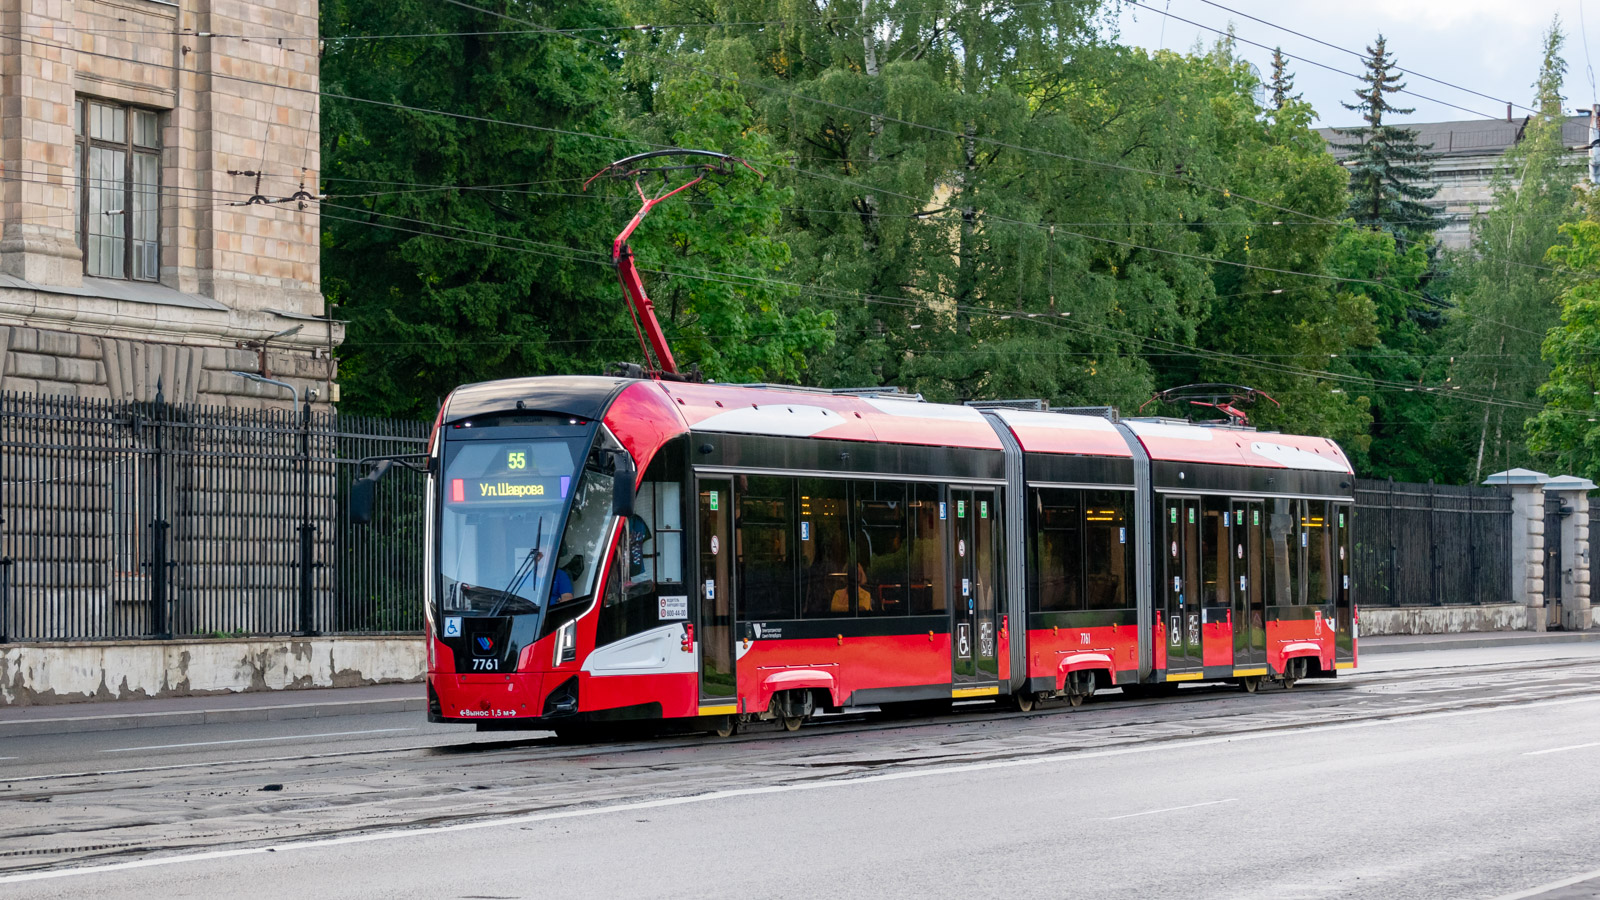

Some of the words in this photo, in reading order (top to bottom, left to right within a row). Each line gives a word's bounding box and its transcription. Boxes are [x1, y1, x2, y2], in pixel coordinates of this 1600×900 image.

[508, 452, 526, 469] 55
[498, 482, 544, 497] Шаврова
[1080, 632, 1091, 645] 7761
[472, 658, 499, 670] 7761
[491, 709, 502, 717] 1,5
